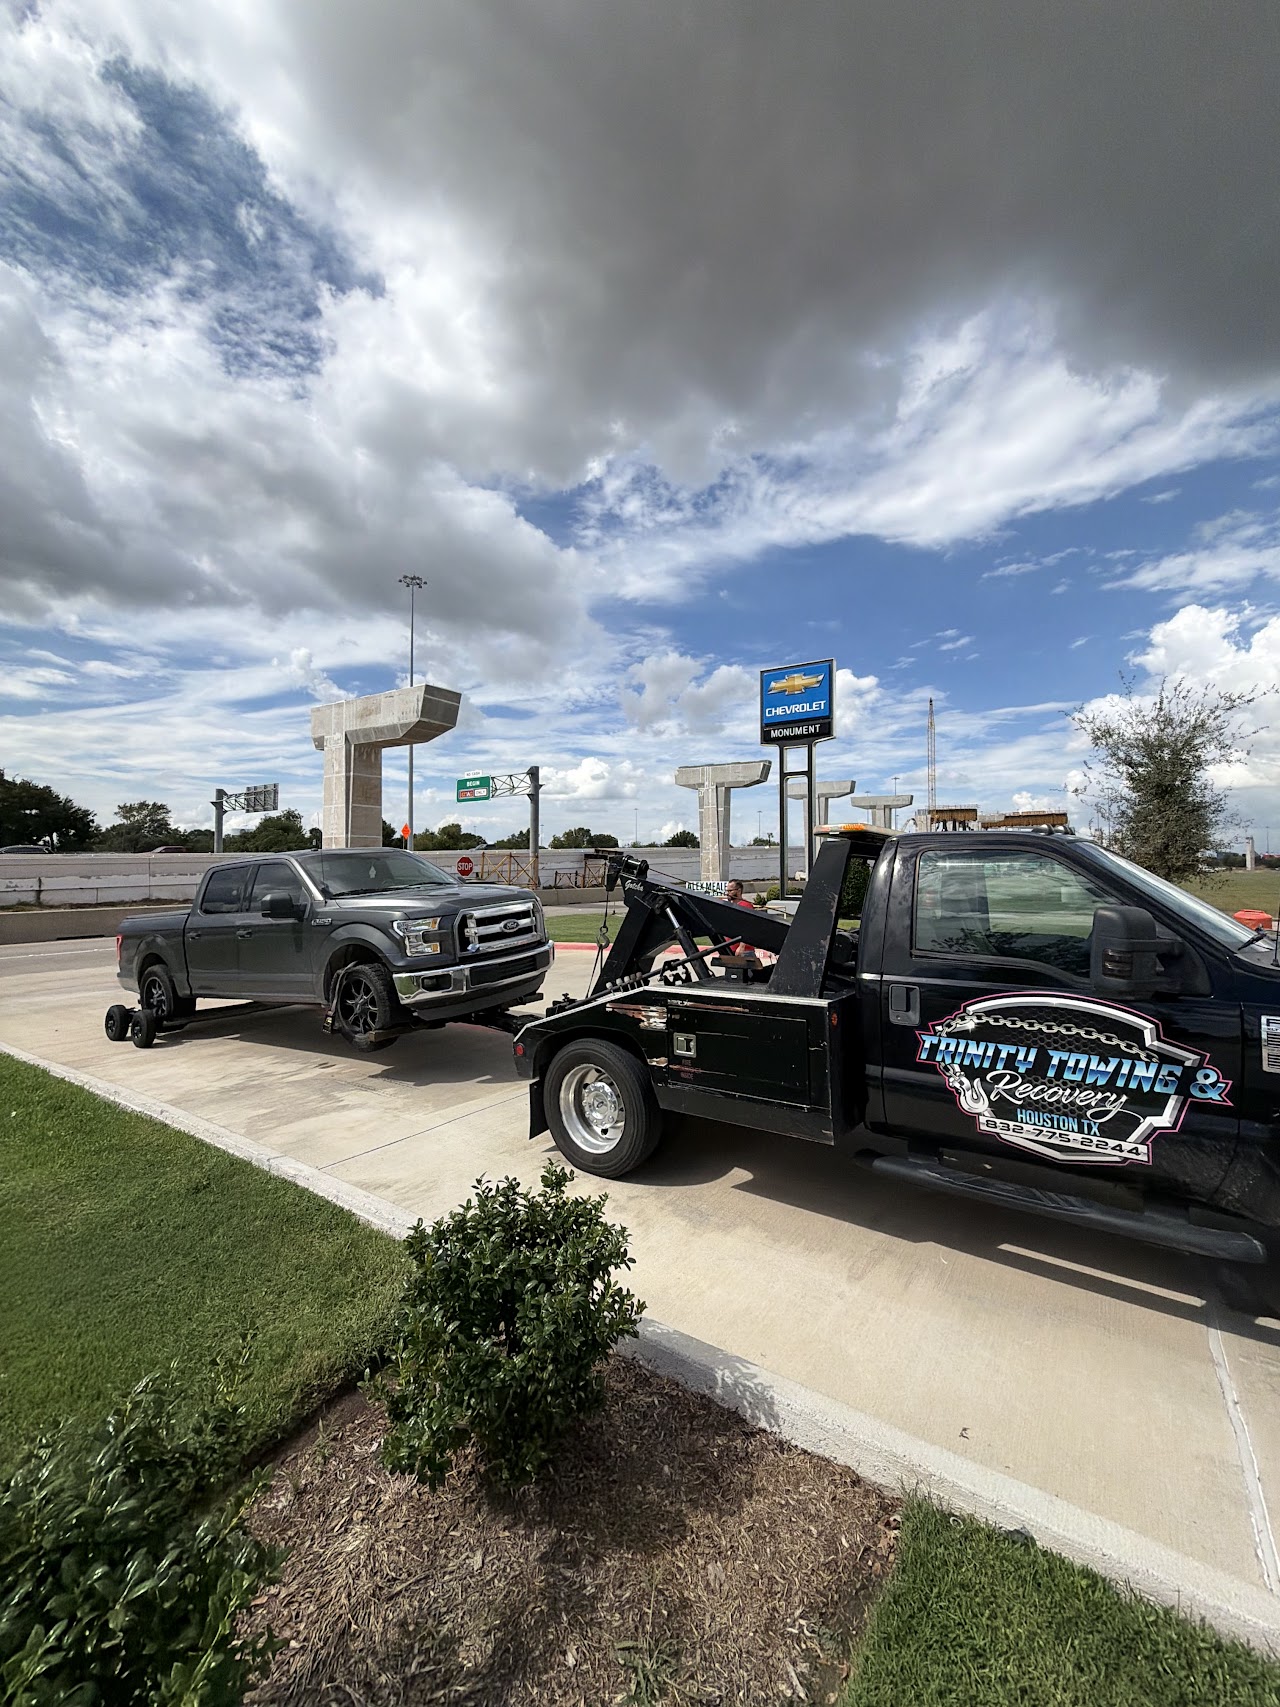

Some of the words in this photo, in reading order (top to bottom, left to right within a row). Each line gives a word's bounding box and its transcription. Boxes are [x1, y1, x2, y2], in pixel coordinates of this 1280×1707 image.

[765, 700, 826, 717] CHEVROLET
[770, 724, 821, 738] MONUMENT
[457, 862, 473, 871] STOP
[920, 1034, 1038, 1074] TRINITY
[1047, 1050, 1184, 1095] TOWING
[1189, 1068, 1226, 1101] &
[986, 1069, 1144, 1123] Recovery
[1016, 1108, 1079, 1133] HOUSTON
[1081, 1119, 1101, 1137] TX
[985, 1119, 1145, 1157] 832-775-2244
